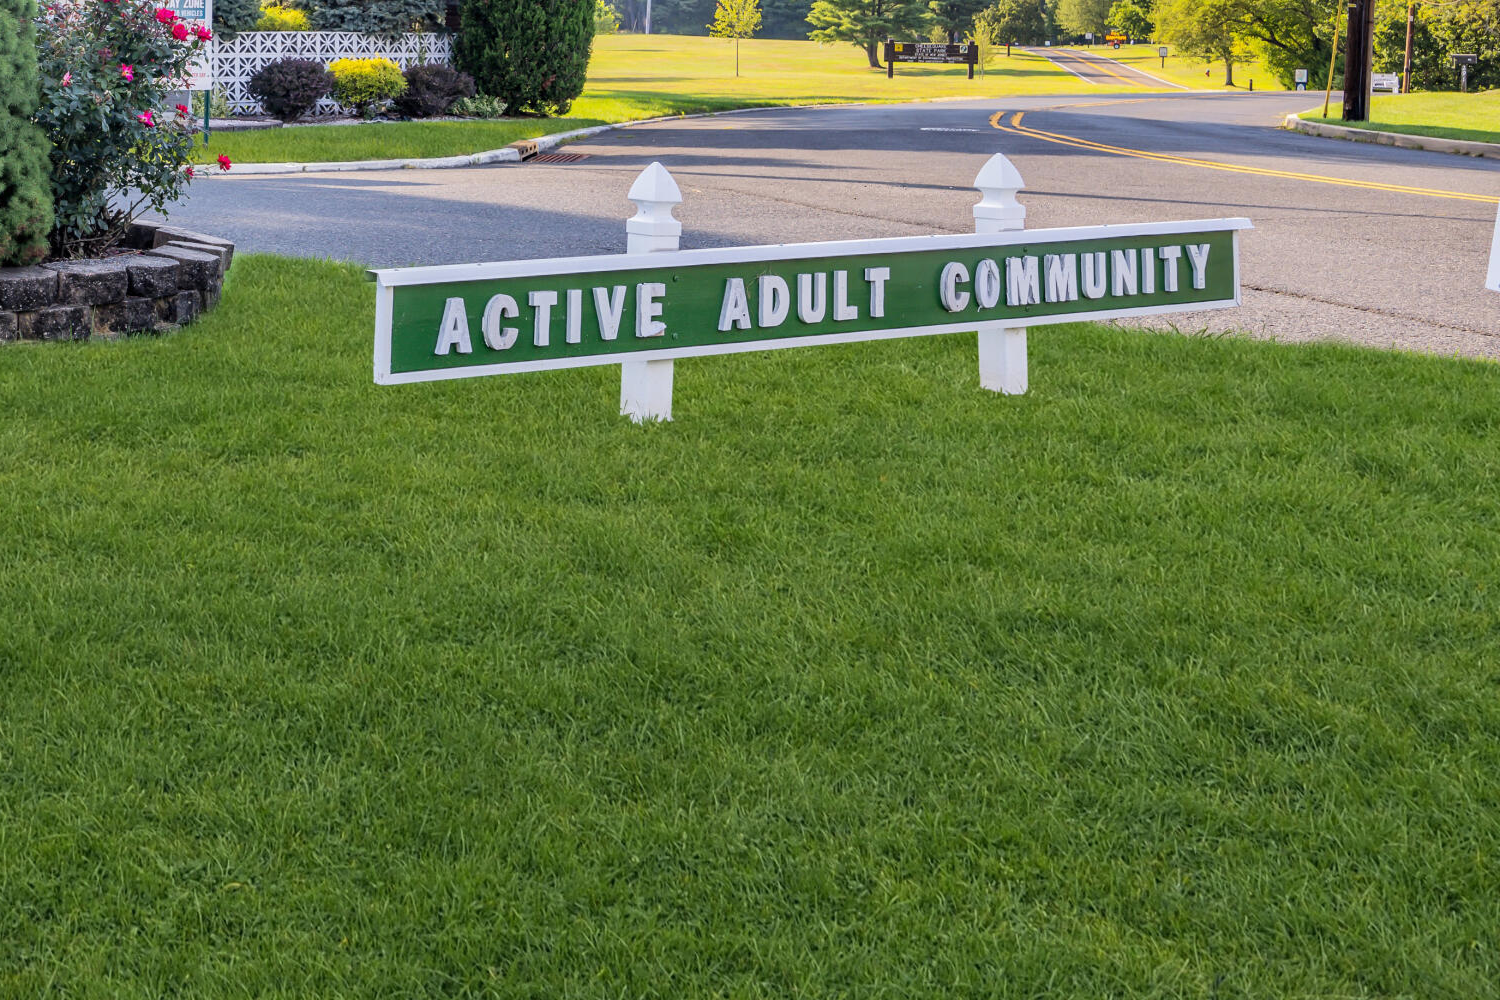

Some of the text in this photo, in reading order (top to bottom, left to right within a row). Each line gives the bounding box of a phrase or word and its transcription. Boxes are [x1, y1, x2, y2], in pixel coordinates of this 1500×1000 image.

[434, 243, 1211, 356] ACTIVE ADULT COMMUNITY
